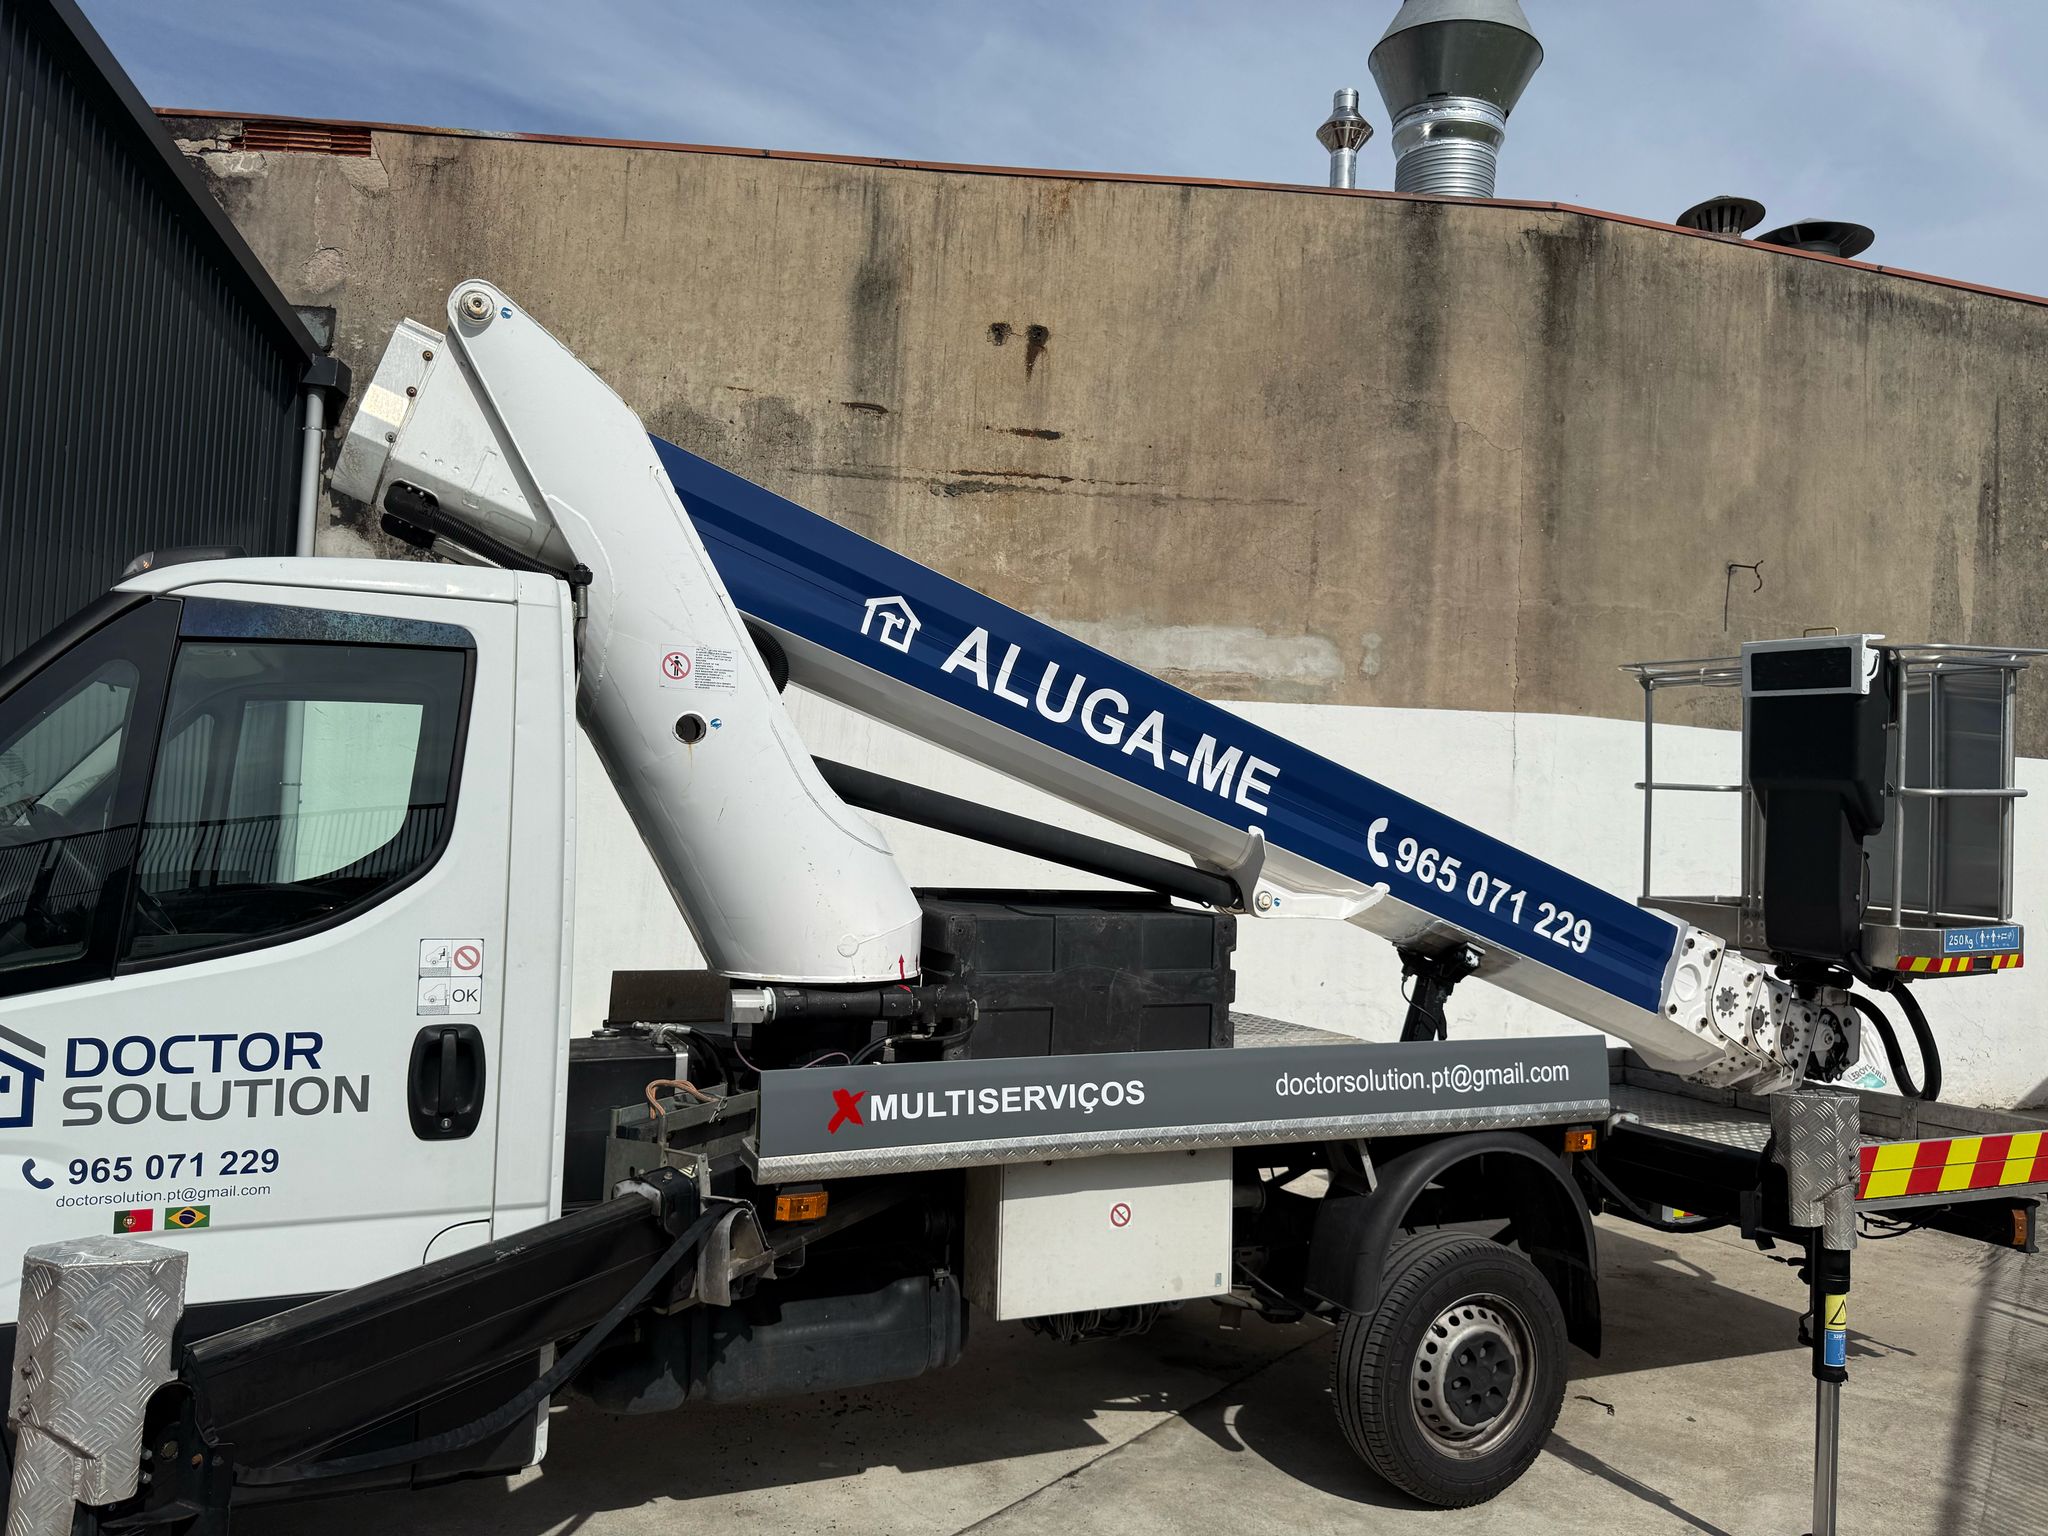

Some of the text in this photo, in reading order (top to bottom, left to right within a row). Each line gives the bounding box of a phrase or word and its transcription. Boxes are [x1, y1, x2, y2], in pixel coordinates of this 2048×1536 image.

[940, 626, 1281, 816] ALUGA-ME
[1395, 837, 1592, 954] 965 071 229
[452, 989, 479, 1002] OK
[65, 1031, 323, 1079] DOCTOR
[1275, 1062, 1570, 1096] doctorsolution.pt@gmail.com
[62, 1074, 370, 1127] SOLUTION
[870, 1080, 1146, 1122] MULTISERVIÇOS
[68, 1148, 280, 1185] 965 071 229
[55, 1184, 271, 1208] doctorsolution.pt@gmail.com
